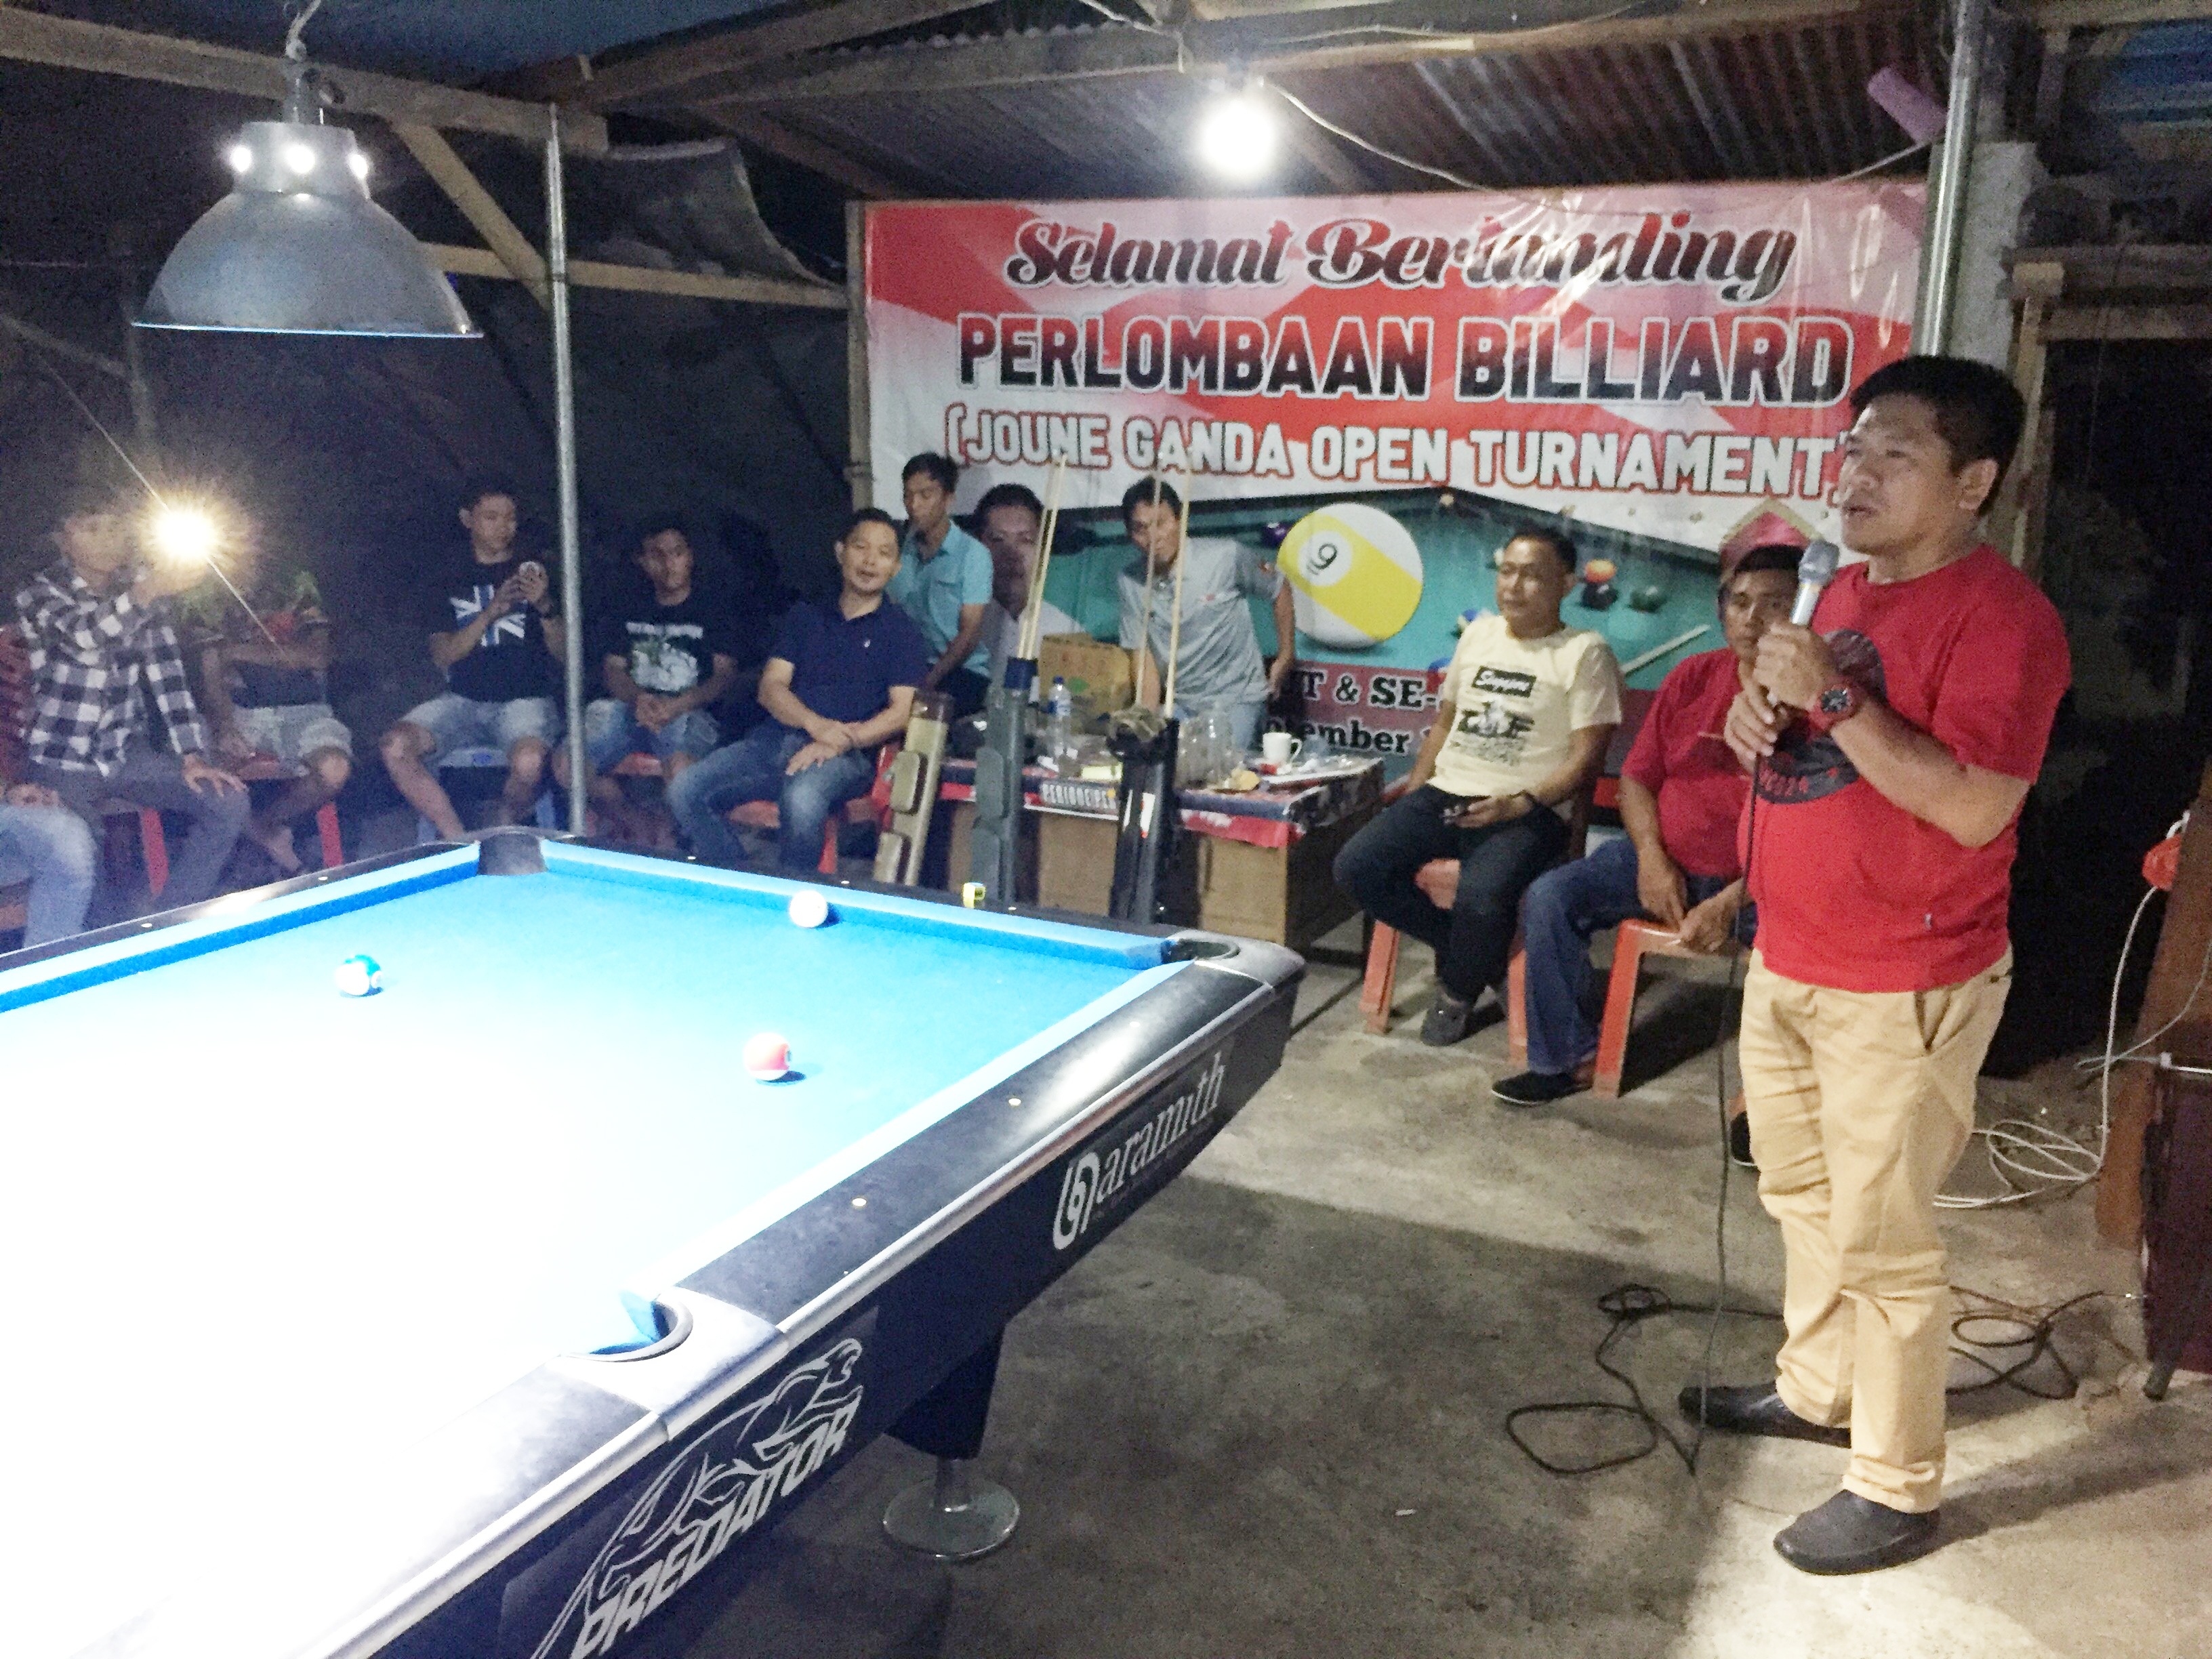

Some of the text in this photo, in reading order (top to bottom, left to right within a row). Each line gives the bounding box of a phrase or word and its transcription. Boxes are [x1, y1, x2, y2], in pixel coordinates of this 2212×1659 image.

[1004, 208, 1799, 304] Selamat Bertanding
[958, 312, 1855, 407] PERLOMBAAN BILLIARD
[1124, 415, 1296, 478] GANDA
[1308, 424, 1452, 485] OPEN
[1334, 674, 1358, 702] &
[1369, 676, 1443, 709] SE-
[570, 1396, 862, 1659] PREDATOR
